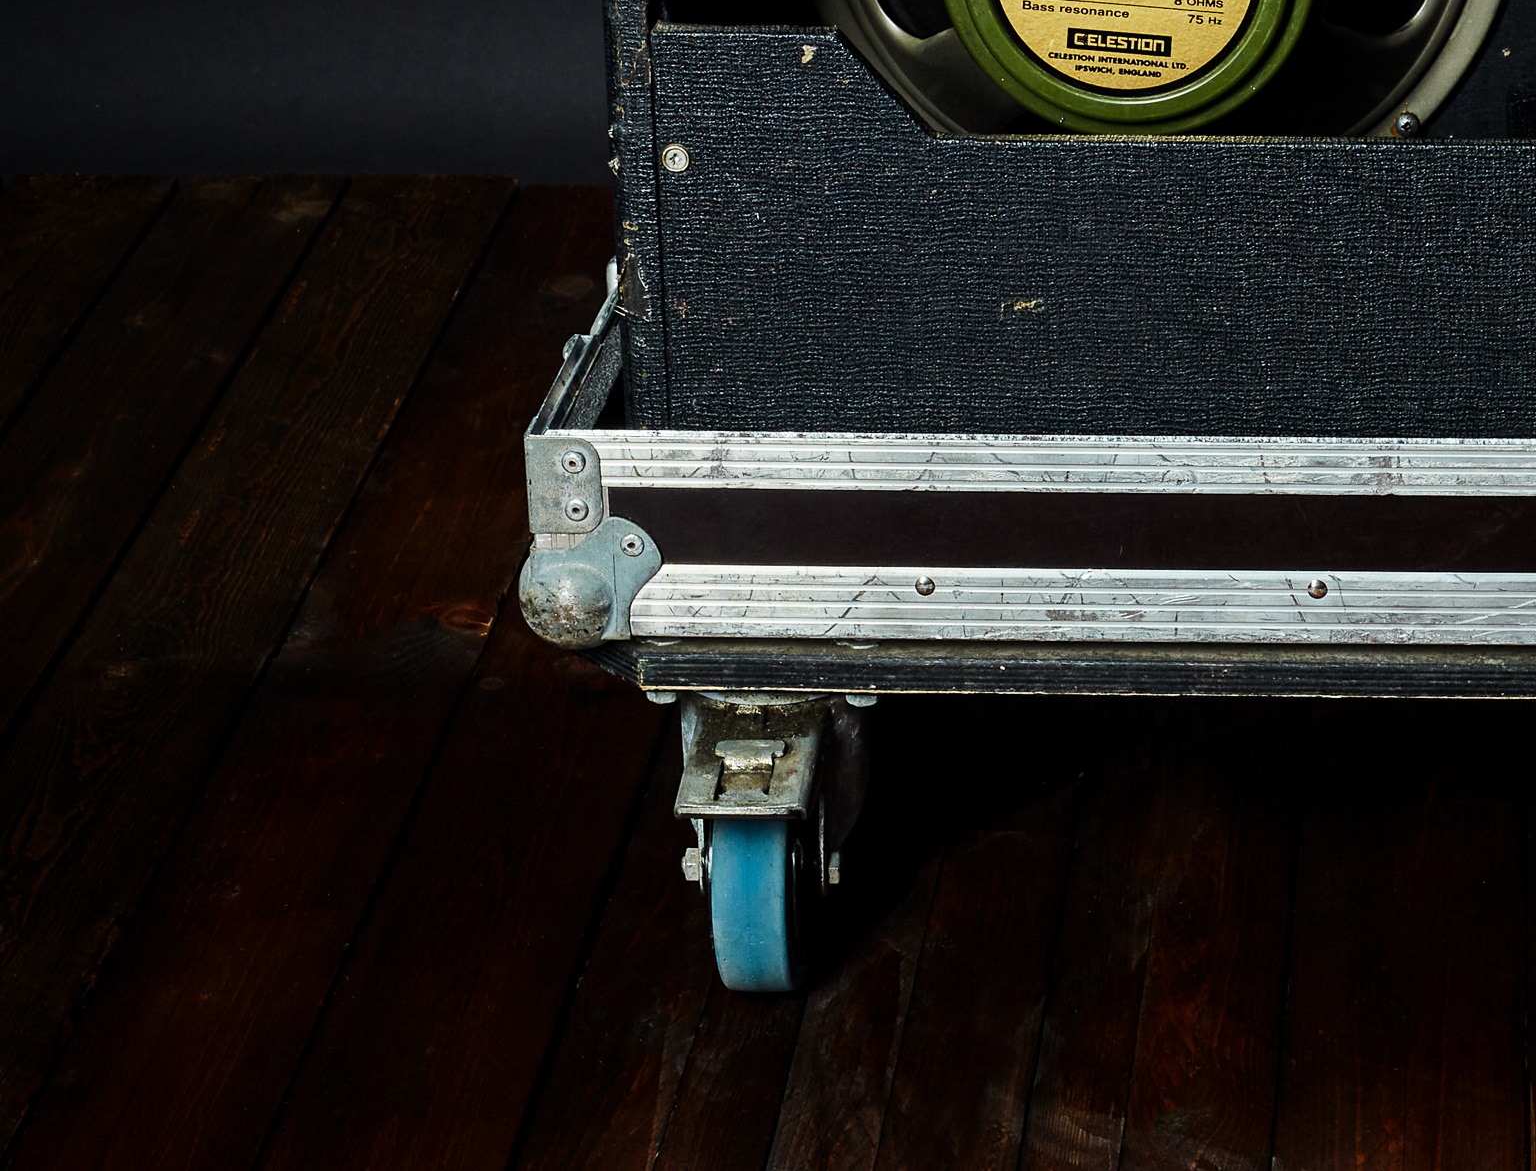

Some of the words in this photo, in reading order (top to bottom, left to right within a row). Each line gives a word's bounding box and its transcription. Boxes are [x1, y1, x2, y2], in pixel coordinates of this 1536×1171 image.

[1022, 0, 1055, 13] Bass
[1059, 6, 1130, 19] resonance
[1187, 14, 1204, 25] 75
[1208, 16, 1223, 25] Hz
[1073, 32, 1165, 53] CELESTION
[1048, 52, 1095, 62] CELESTION
[1098, 56, 1168, 69] INTERNATIONAL
[1171, 62, 1190, 70] LTD.
[1074, 65, 1115, 76] IPSWICH,
[1118, 68, 1162, 78] ENGLAND
